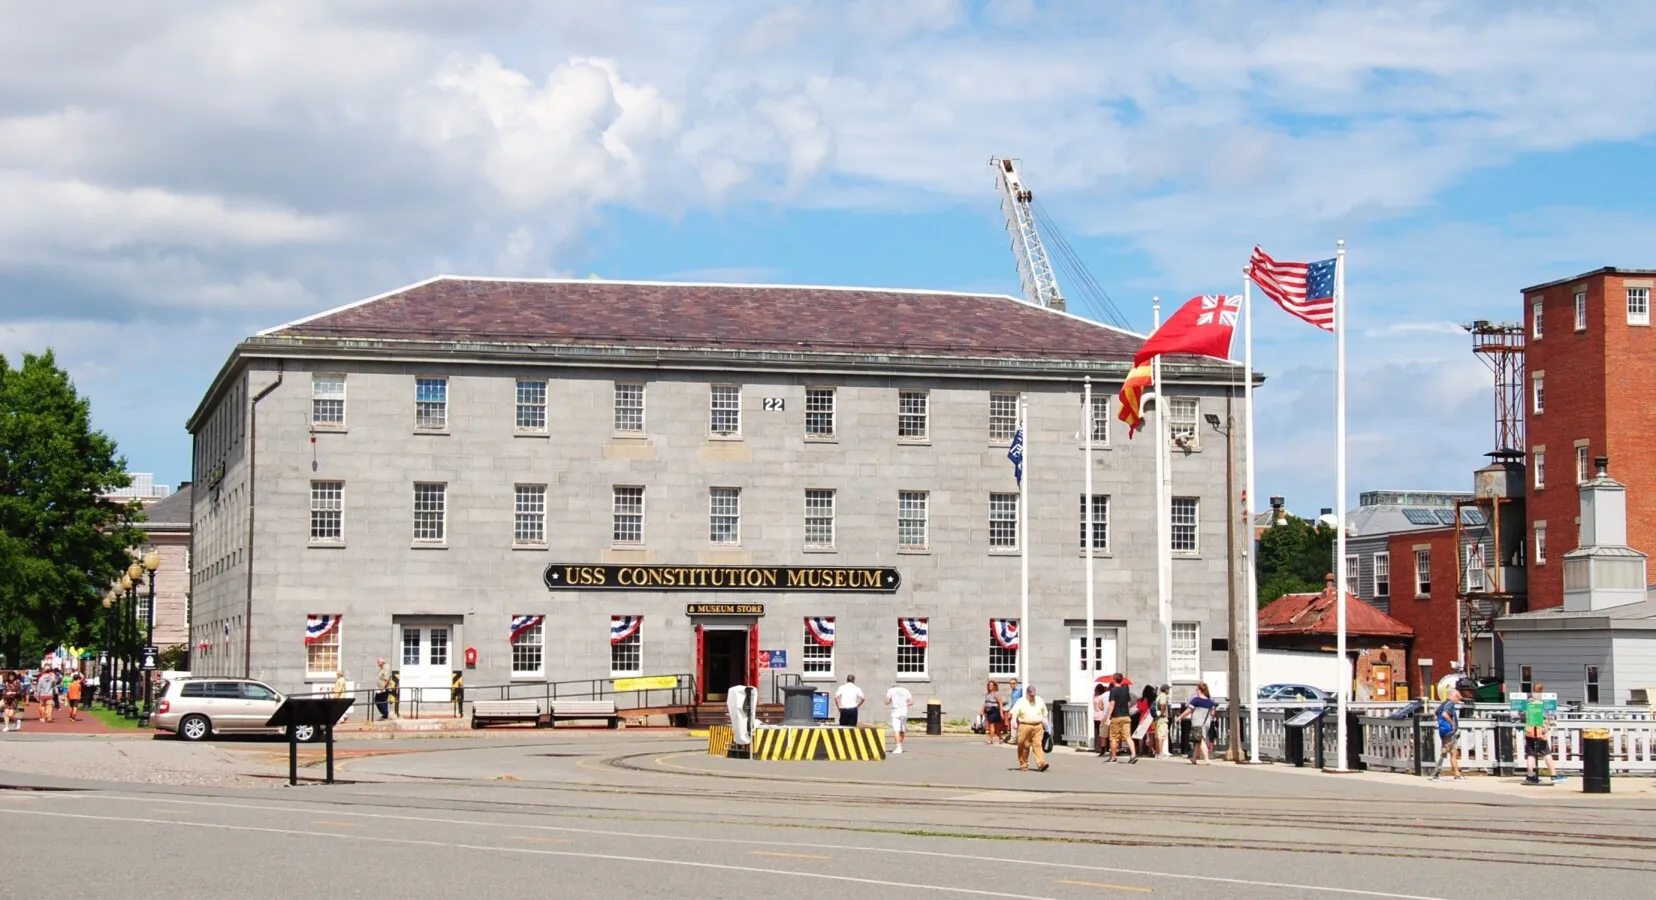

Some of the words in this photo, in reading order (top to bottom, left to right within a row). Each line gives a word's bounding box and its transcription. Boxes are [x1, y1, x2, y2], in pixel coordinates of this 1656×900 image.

[764, 398, 783, 411] 22
[565, 567, 606, 585] USS
[617, 567, 778, 587] CONSTITUTION
[786, 569, 883, 588] MUSEUM
[697, 605, 735, 613] MUSEUM
[736, 605, 763, 613] STORE
